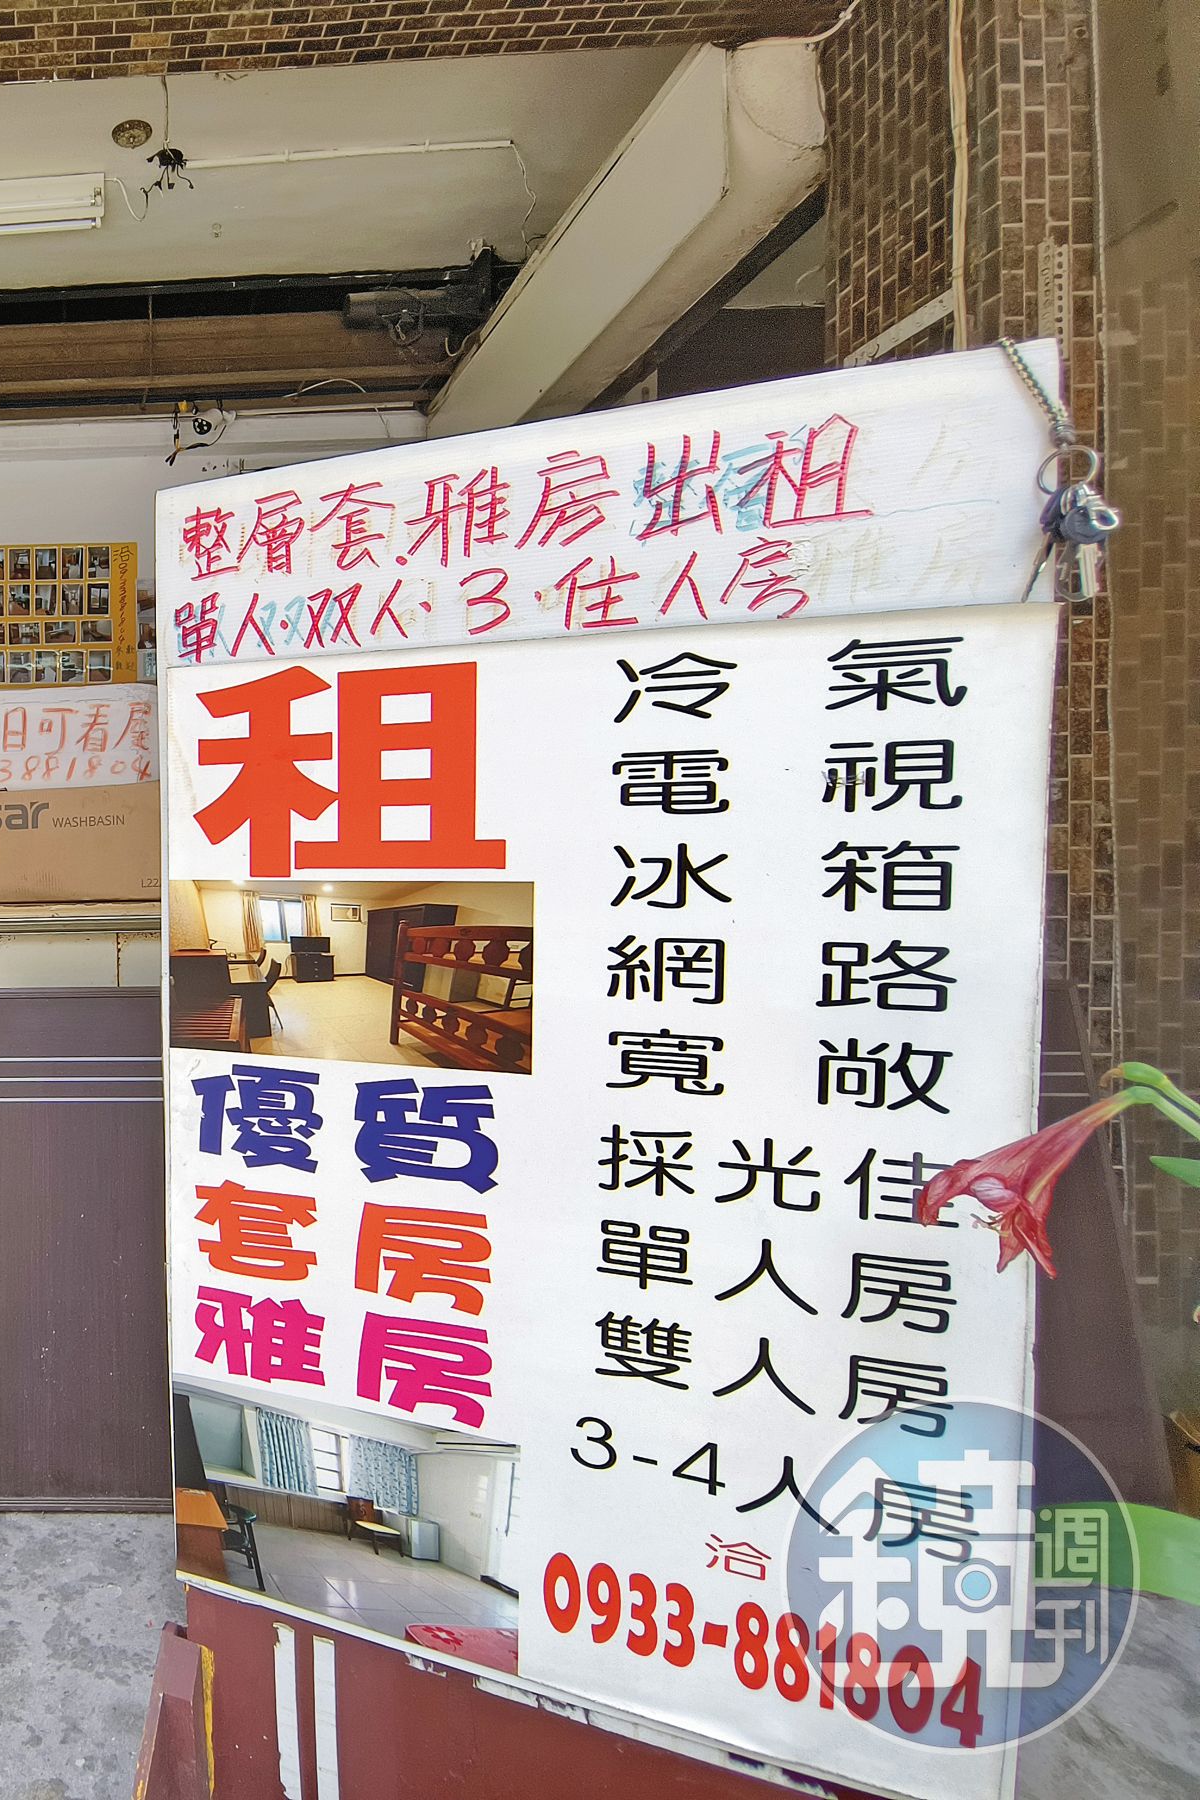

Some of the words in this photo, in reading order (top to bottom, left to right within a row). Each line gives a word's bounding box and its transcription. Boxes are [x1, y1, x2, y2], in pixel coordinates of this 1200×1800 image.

[613, 636, 968, 724] 冷氣
[51, 814, 125, 828] WASHBASIN
[194, 661, 507, 879] 租
[612, 739, 963, 815] 電視
[610, 840, 960, 912] 冰箱
[606, 934, 957, 1012] 網路
[605, 1028, 954, 1115] 寬敞
[191, 1064, 499, 1194] 優質
[597, 1124, 959, 1228] 採光佳
[194, 1180, 492, 1316] 套房
[596, 1219, 958, 1334] 單人房
[195, 1285, 493, 1429] 雅房
[595, 1311, 954, 1438] 雙人房
[570, 1416, 980, 1562] 3-4人房
[704, 1533, 772, 1581] 洽
[543, 1552, 985, 1749] 0933-881804
